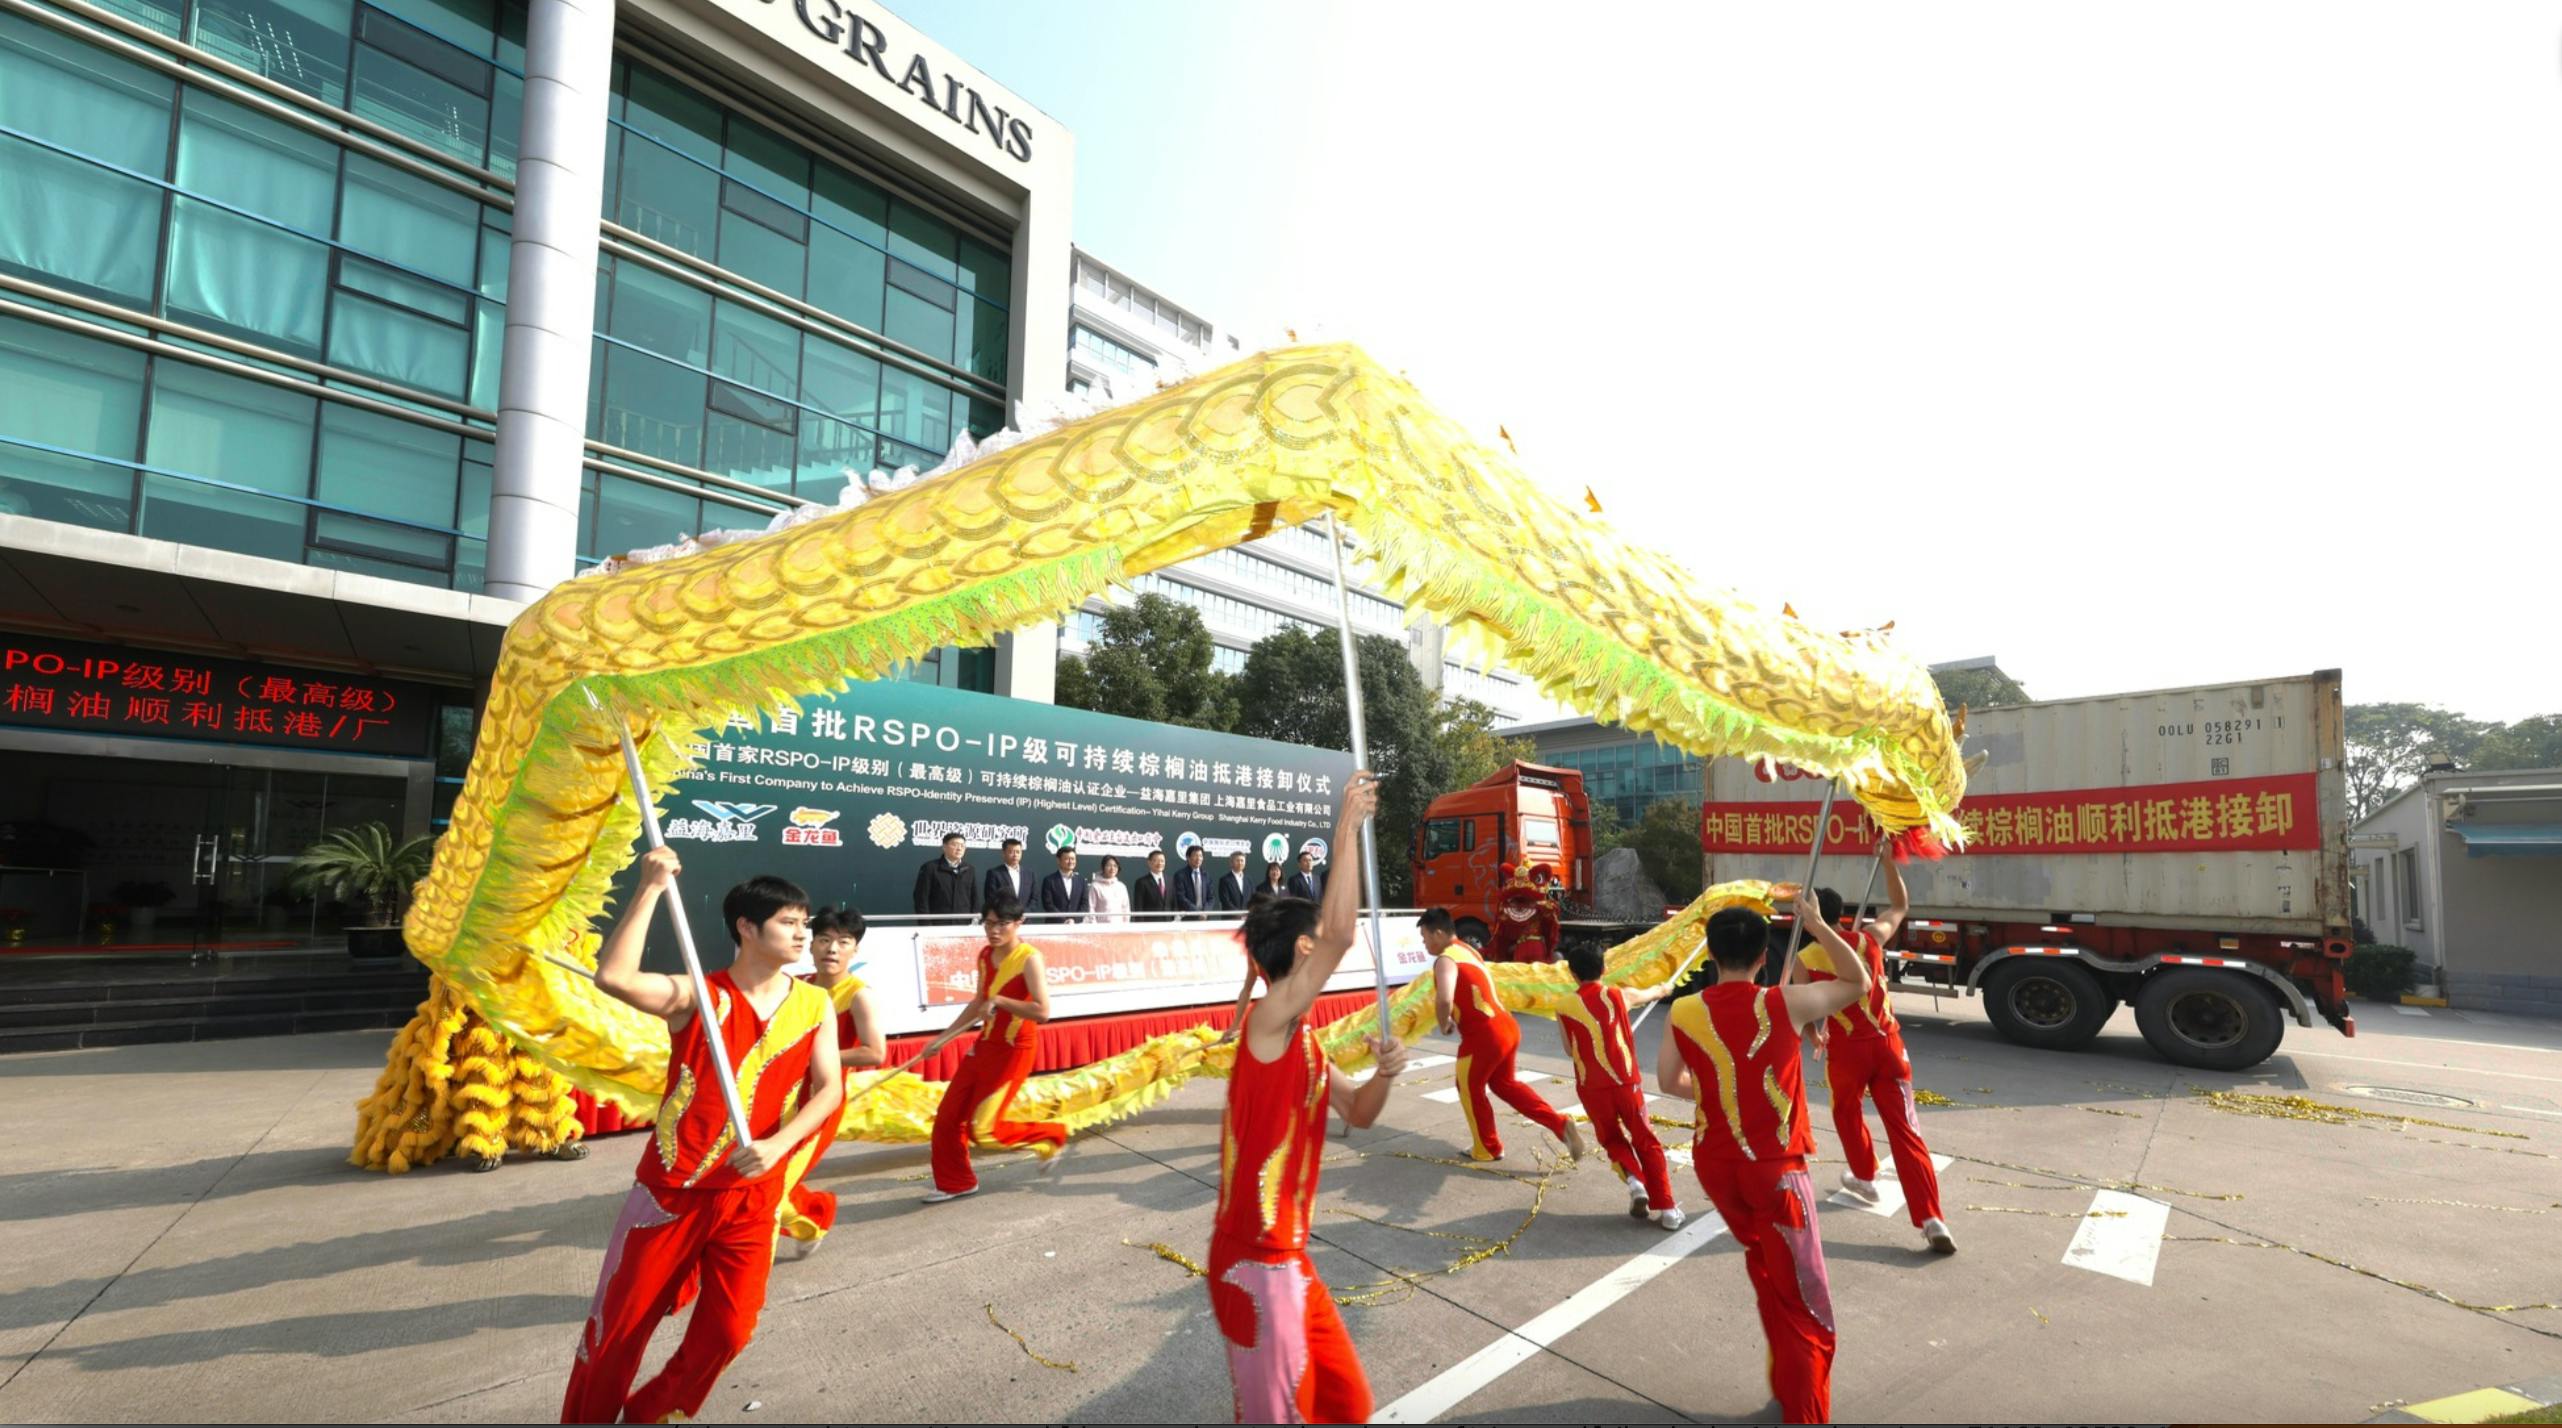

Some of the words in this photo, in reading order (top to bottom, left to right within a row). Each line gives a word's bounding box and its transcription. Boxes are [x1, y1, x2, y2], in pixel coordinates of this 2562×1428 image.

[792, 0, 1033, 163] GRAINS
[2205, 719, 2261, 733] 058291
[2206, 732, 2242, 745] 22G1
[720, 771, 751, 784] First
[754, 774, 818, 792] Company
[821, 780, 834, 791] to
[836, 781, 884, 795] Achieve
[887, 785, 963, 803] RSPO-Identity
[965, 792, 1014, 806] Preserved
[1015, 797, 1031, 808] (IP)
[1033, 798, 1070, 811] (Highest
[1072, 801, 1097, 813] Level)
[1171, 809, 1191, 821] Kerry
[1192, 811, 1214, 822] Group
[1218, 813, 1248, 824] Shanghai
[1250, 816, 1267, 826] Kerry
[1268, 816, 1282, 826] Food
[1284, 817, 1306, 829] Industry
[784, 827, 838, 845] 金龙鱼
